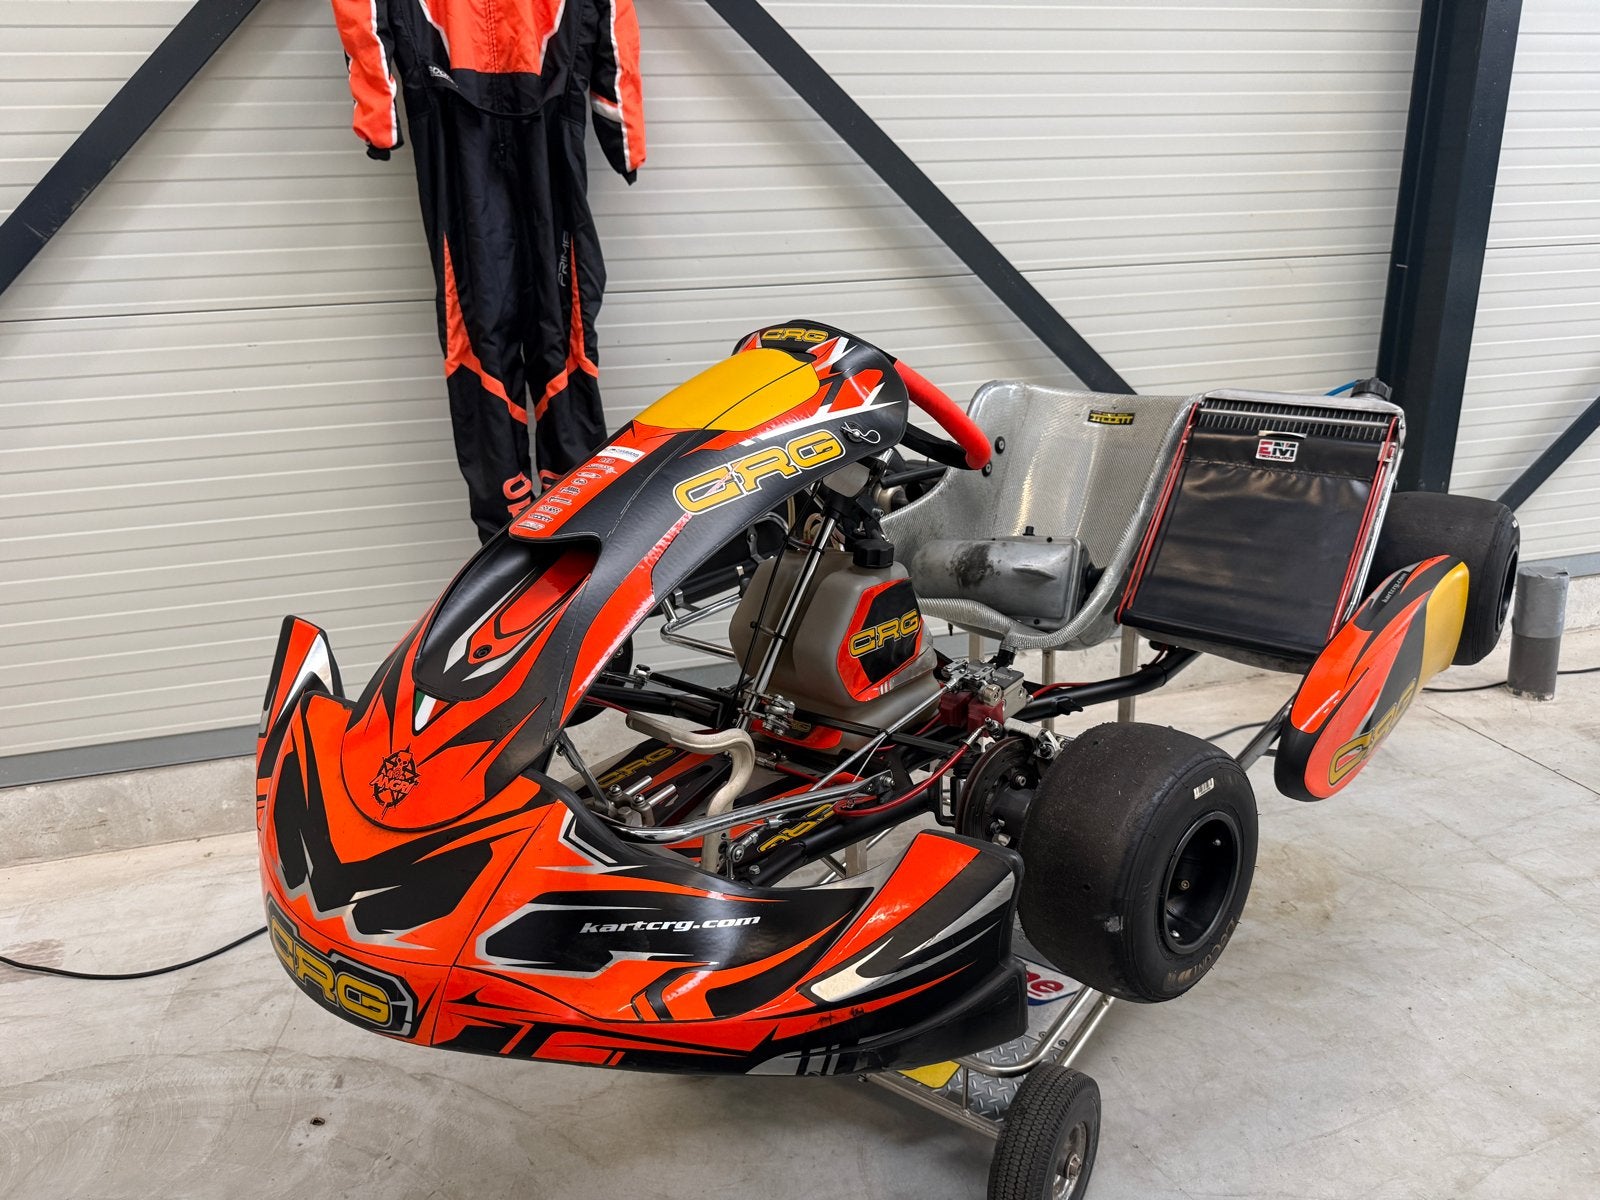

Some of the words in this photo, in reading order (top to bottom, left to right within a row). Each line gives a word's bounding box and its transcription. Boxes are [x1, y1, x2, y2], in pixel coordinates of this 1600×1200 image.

[761, 328, 828, 342] CRG
[673, 429, 845, 514] CRG
[848, 609, 920, 658] CRG
[579, 916, 761, 934] kartcrg.com
[271, 915, 393, 1027] CRG
